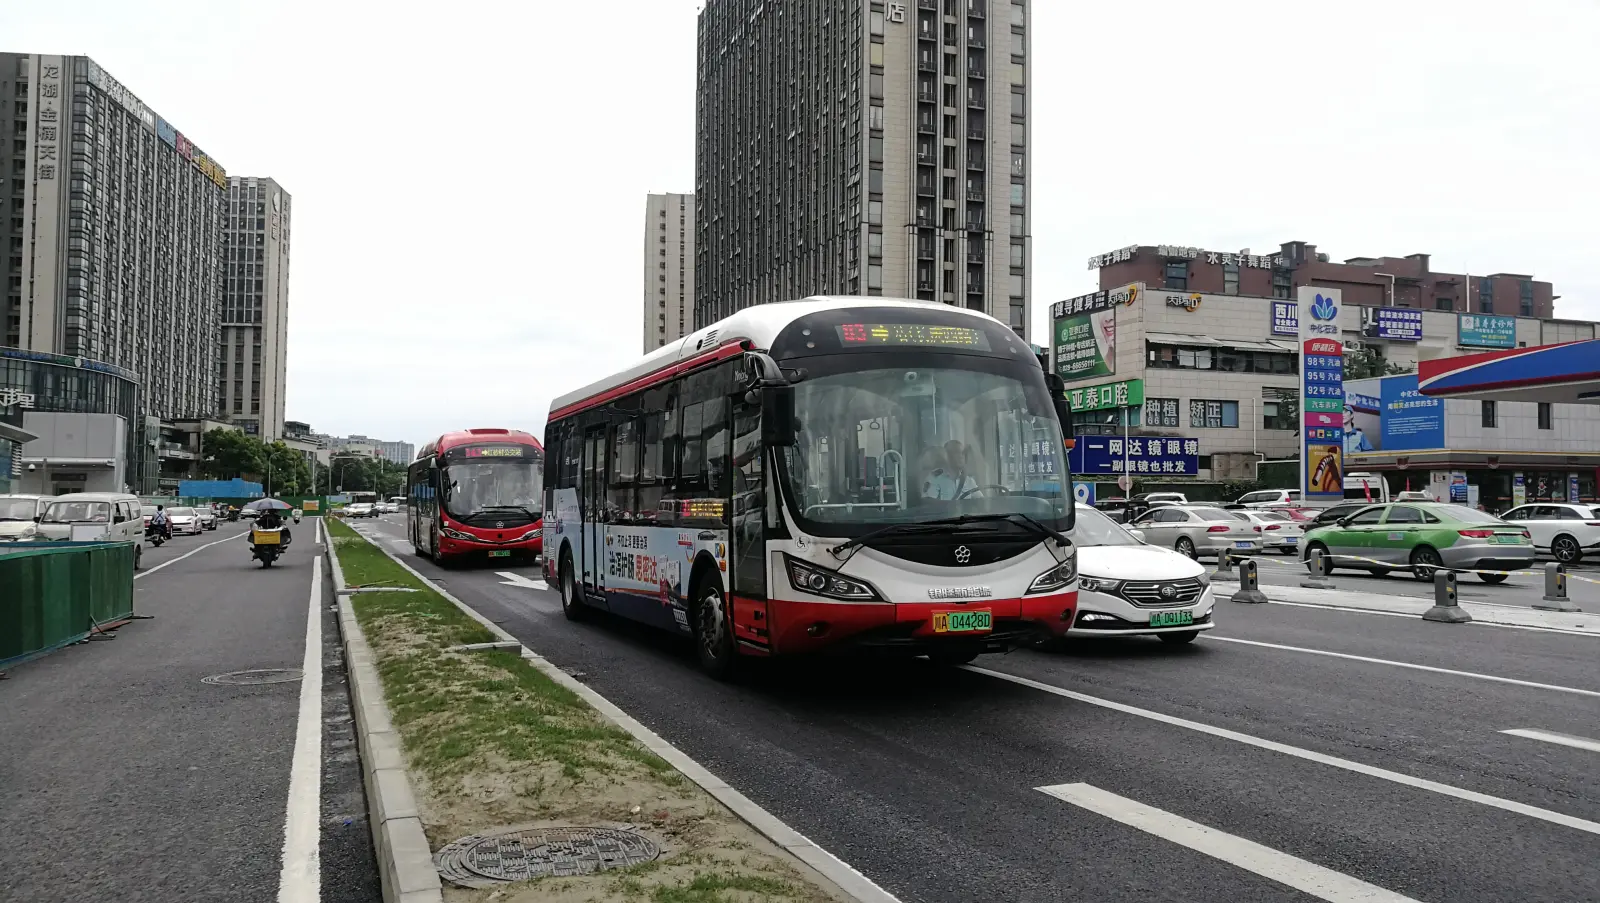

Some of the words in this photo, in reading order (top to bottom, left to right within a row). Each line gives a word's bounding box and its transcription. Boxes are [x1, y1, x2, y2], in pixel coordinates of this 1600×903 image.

[886, 2, 906, 23] 店
[1207, 252, 1271, 269] 水灵子舞蹈
[1054, 294, 1093, 317] 健寻健身
[1307, 357, 1326, 366] 98号
[1327, 358, 1341, 367] 汽油
[1307, 371, 1326, 380] 95号
[1327, 373, 1341, 381] 汽油
[1071, 382, 1129, 410] 亚泰口腔
[1307, 386, 1326, 395] 92号
[1328, 387, 1342, 396] 汽油
[1146, 400, 1178, 417] 种植
[1190, 401, 1222, 418] 矫正
[1099, 460, 1186, 473] 一副眼镜也批发
[952, 614, 990, 629] 04428D
